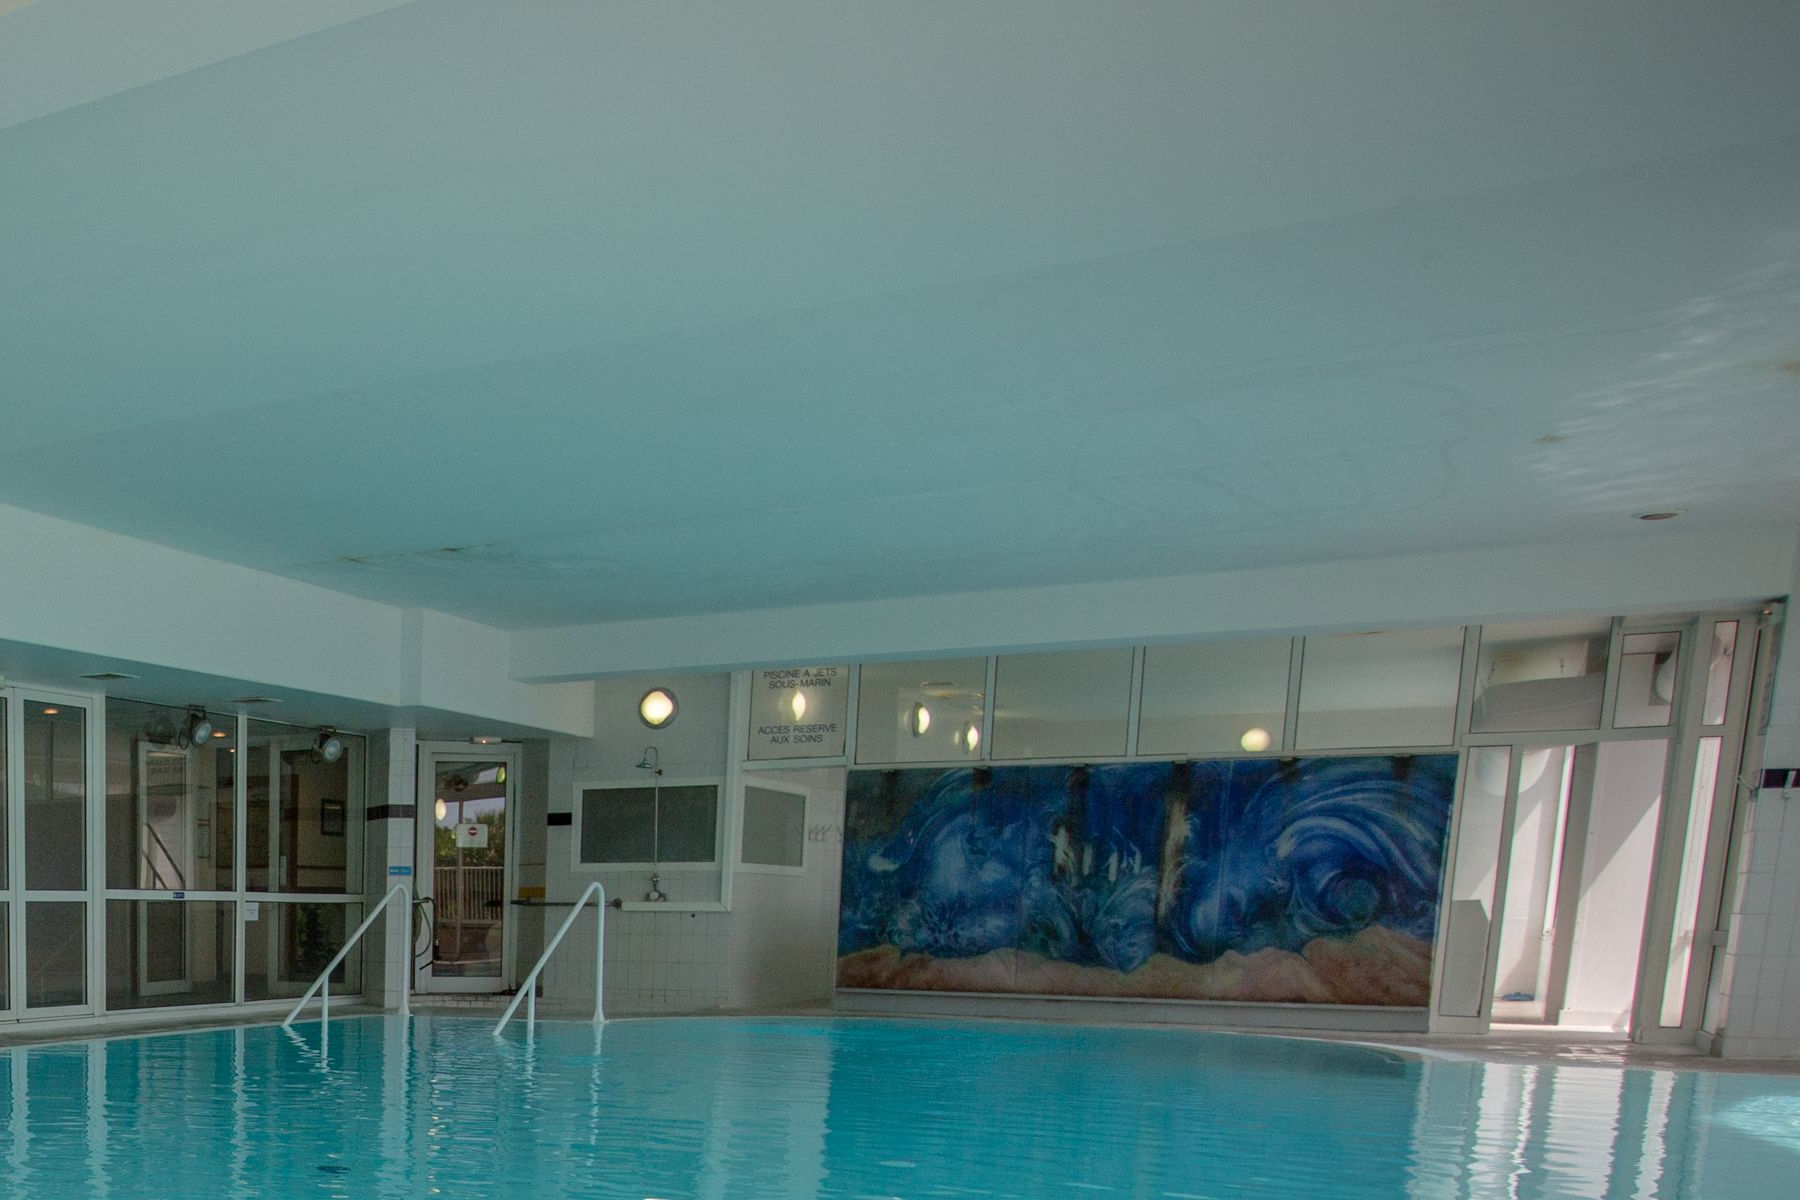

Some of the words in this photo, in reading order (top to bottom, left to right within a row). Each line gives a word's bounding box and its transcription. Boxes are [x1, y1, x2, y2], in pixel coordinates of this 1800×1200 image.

[763, 669, 800, 680] PISCINE
[814, 667, 838, 677] JETS
[768, 678, 832, 690] SOUS-MARIN
[770, 735, 790, 744] AUX
[793, 734, 824, 744] SOINS
